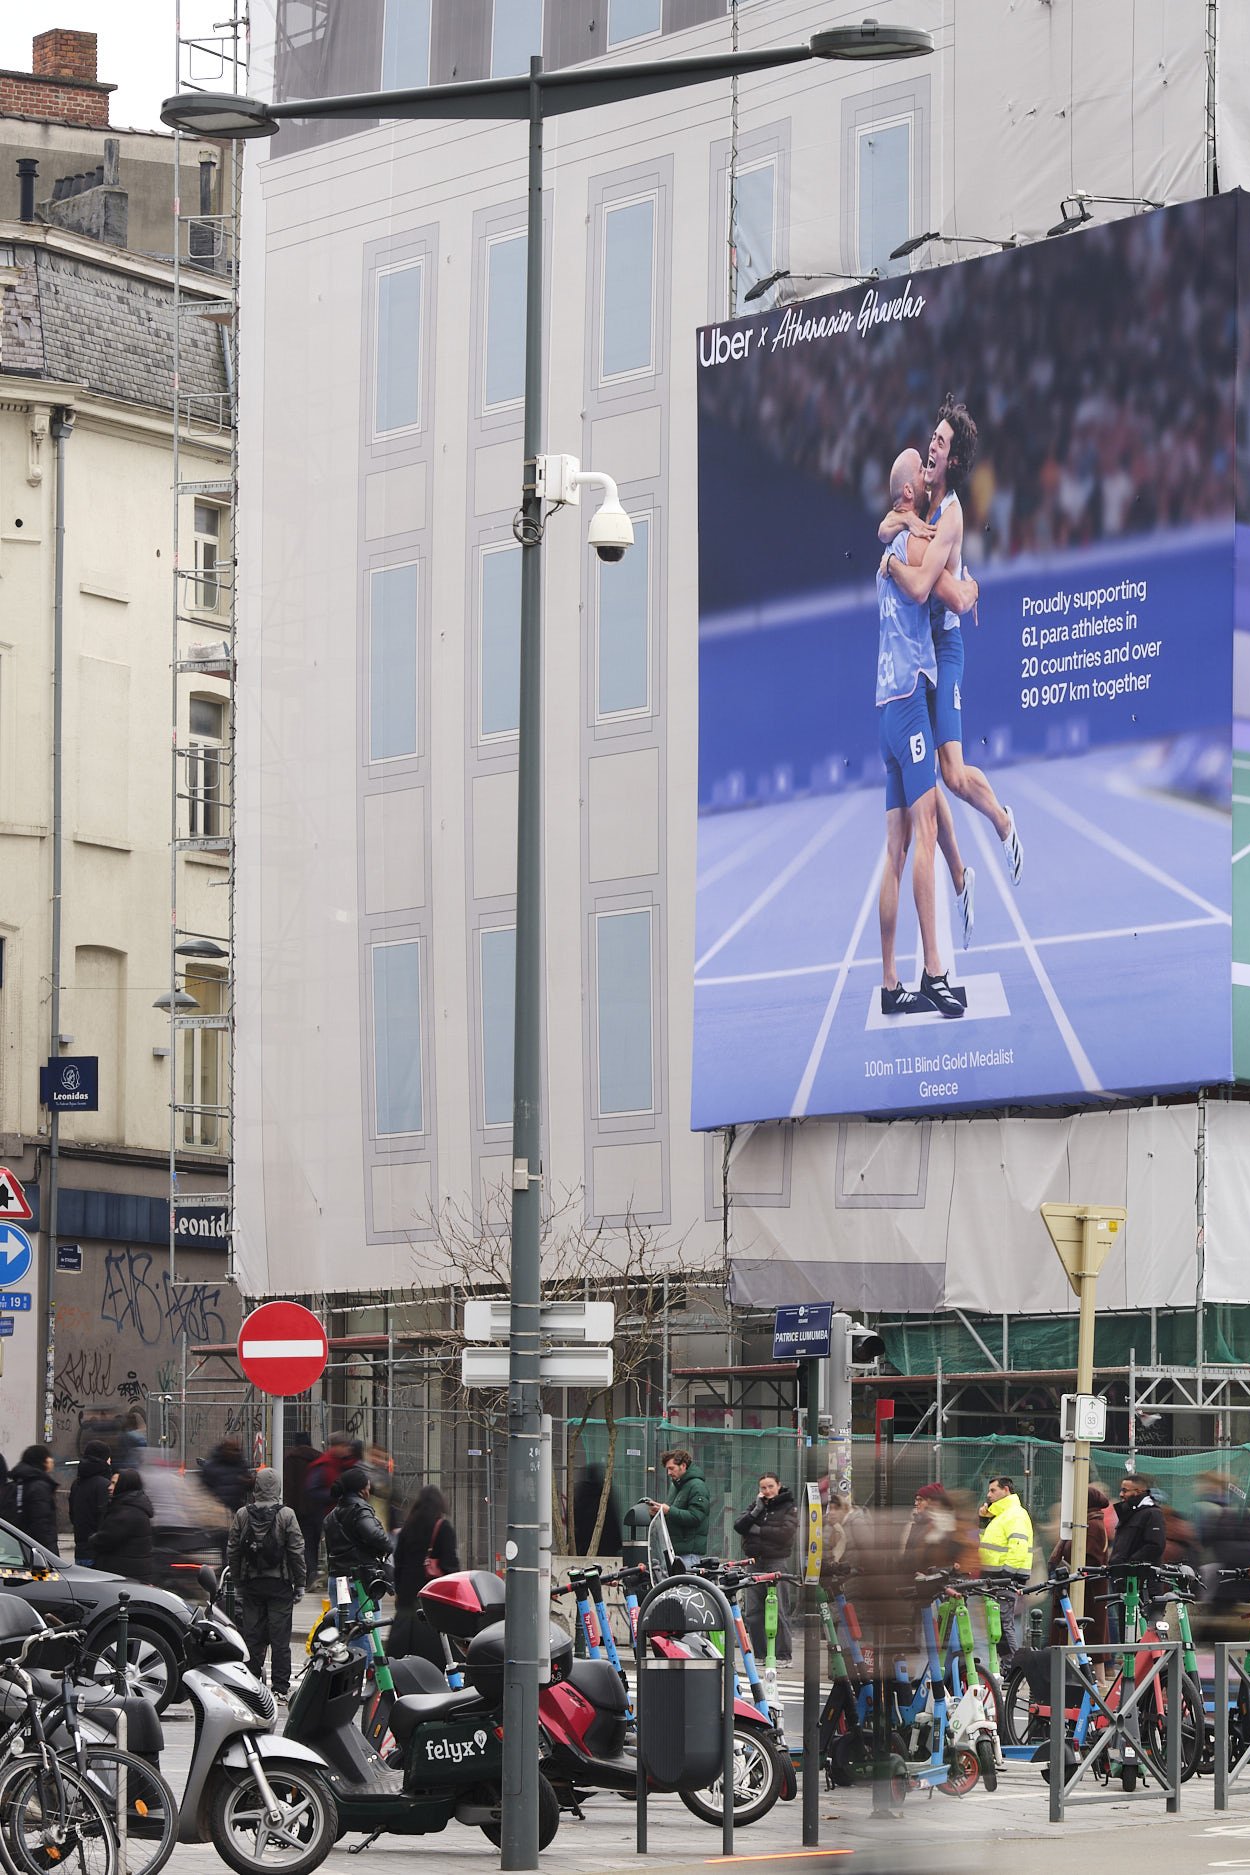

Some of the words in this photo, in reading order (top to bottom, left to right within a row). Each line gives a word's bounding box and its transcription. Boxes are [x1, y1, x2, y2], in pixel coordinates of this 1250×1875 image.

[700, 327, 754, 368] Uber
[856, 280, 927, 338] Ghavelas
[1022, 590, 1072, 617] Proudly
[1073, 579, 1147, 611] supporting
[1021, 626, 1038, 647] 61
[1040, 624, 1069, 649] para
[1071, 615, 1124, 640] athletes
[1125, 610, 1137, 630] in
[1021, 656, 1038, 678] 20
[1040, 649, 1101, 675] countries
[1103, 641, 1130, 668] and
[1131, 640, 1162, 660] over
[1021, 687, 1039, 709] 90
[1041, 682, 1067, 706] 907
[1069, 681, 1090, 701] km
[1092, 672, 1151, 700] together
[915, 738, 922, 755] 5
[864, 1060, 894, 1077] 100m
[895, 1058, 913, 1074] T11
[915, 1054, 940, 1073] Blind
[942, 1052, 967, 1070] Gold
[969, 1048, 1014, 1068] Medalist
[53, 1091, 89, 1100] Leonidas
[919, 1081, 959, 1097] Greece
[174, 1212, 229, 1238] eonid
[10, 1297, 21, 1308] 19
[775, 1332, 799, 1343] PATRICE
[799, 1330, 828, 1341] LUMUMBA
[1087, 1417, 1096, 1425] 33
[820, 1602, 831, 1621] Bolt
[425, 1739, 476, 1763] felyx
